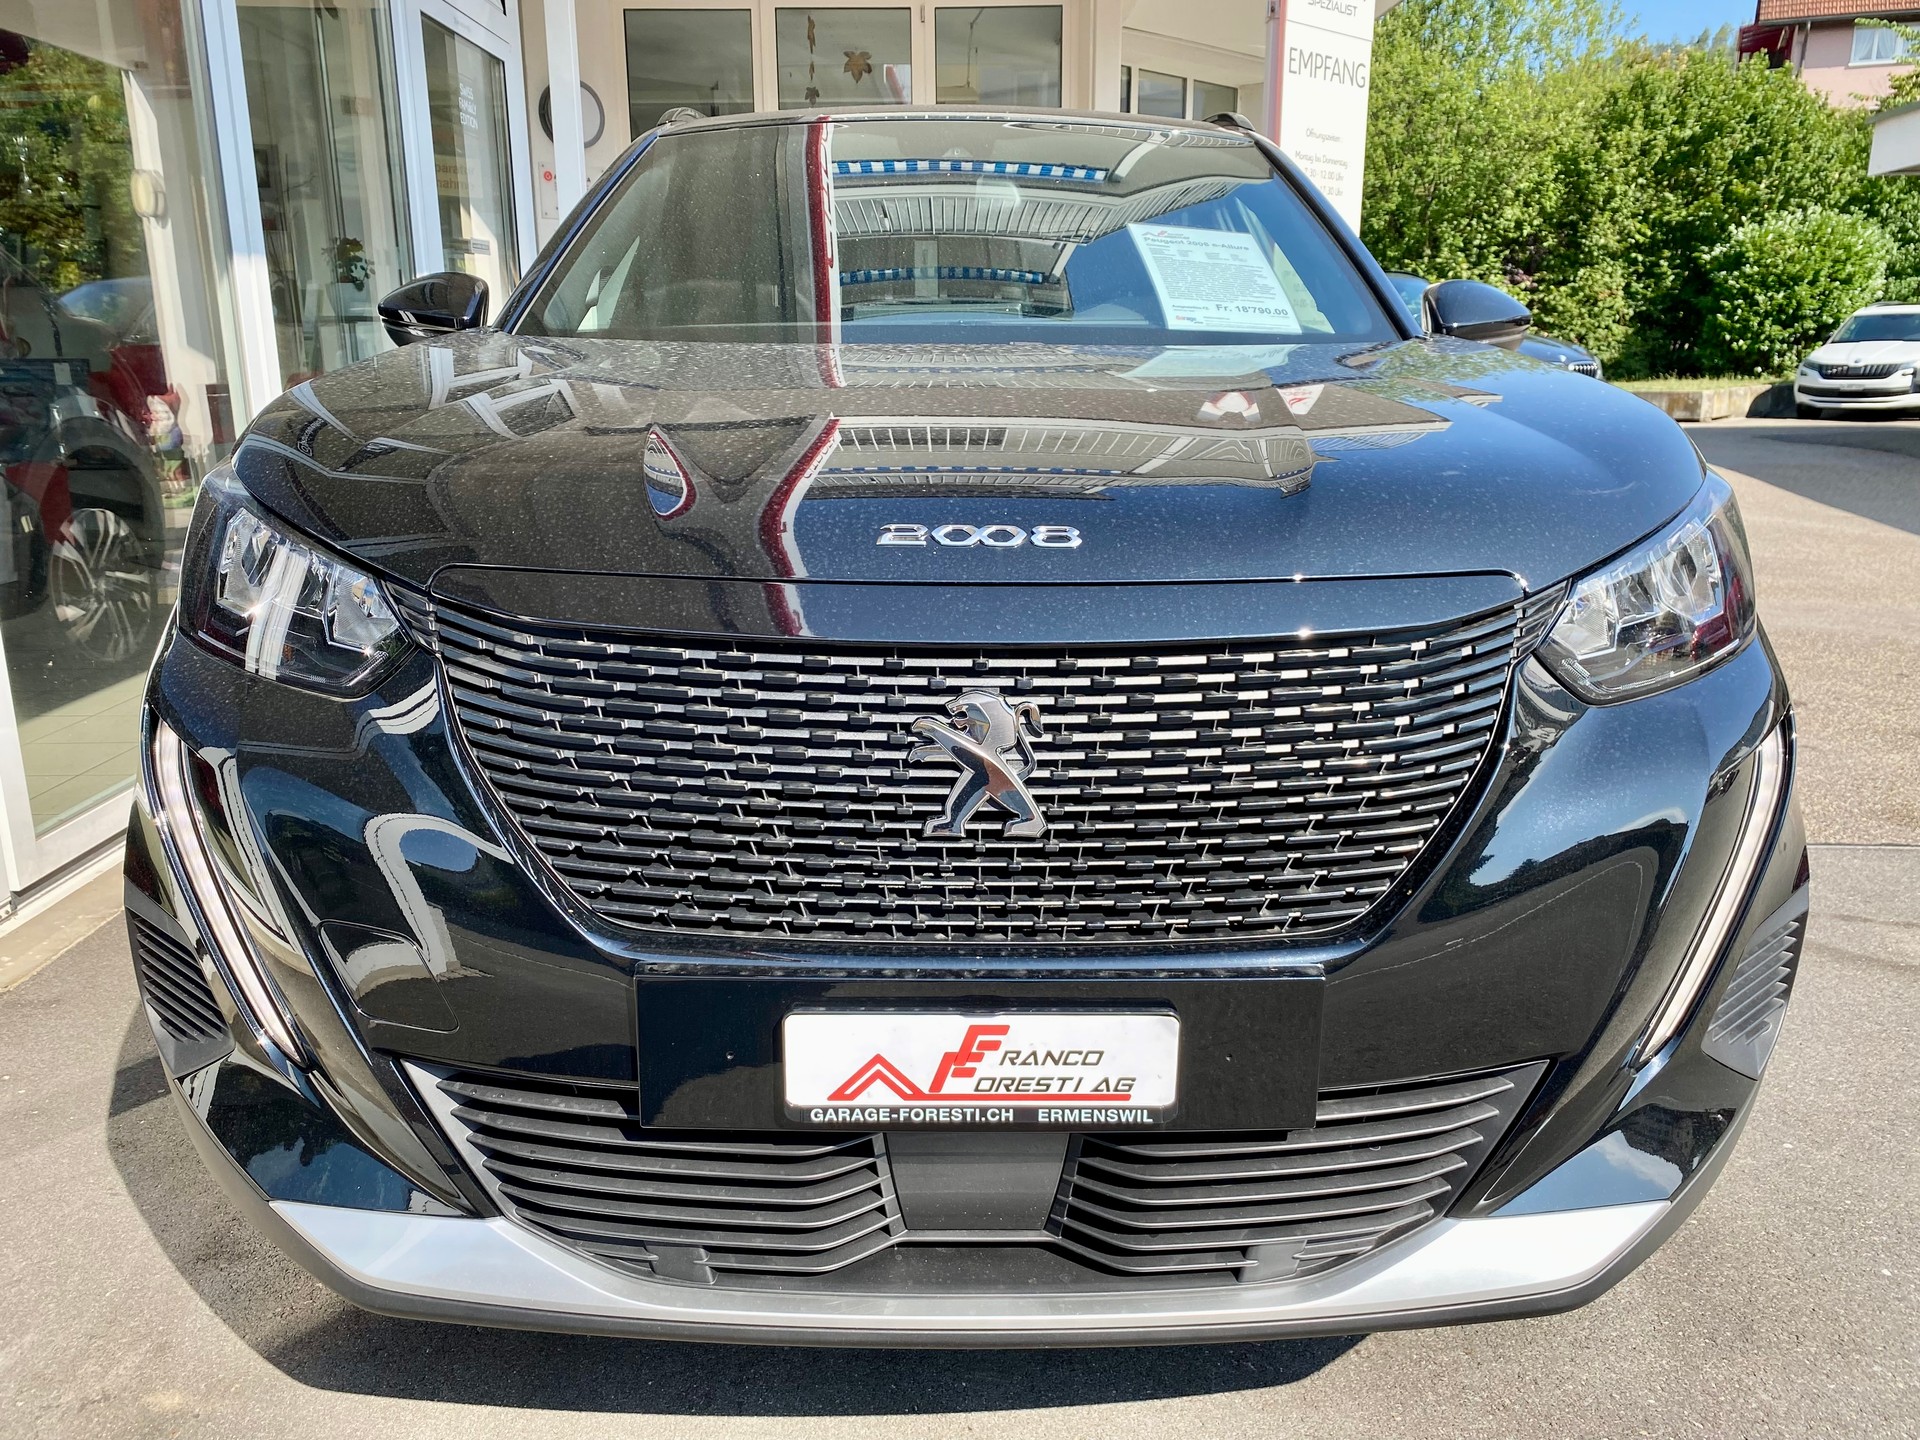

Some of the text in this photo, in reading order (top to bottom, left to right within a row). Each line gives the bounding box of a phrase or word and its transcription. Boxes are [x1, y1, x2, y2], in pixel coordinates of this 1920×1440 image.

[1288, 47, 1366, 88] EMPFANG
[460, 111, 479, 130] EDITION
[1143, 236, 1185, 245] Peugeot
[1216, 303, 1233, 312] Fr.
[1235, 305, 1289, 316] 18'790.00
[876, 524, 1083, 548] 2008
[1090, 1076, 1136, 1093] AG
[810, 1108, 1153, 1124] GARAGE-FORESTI.CH ERMENSWIL
